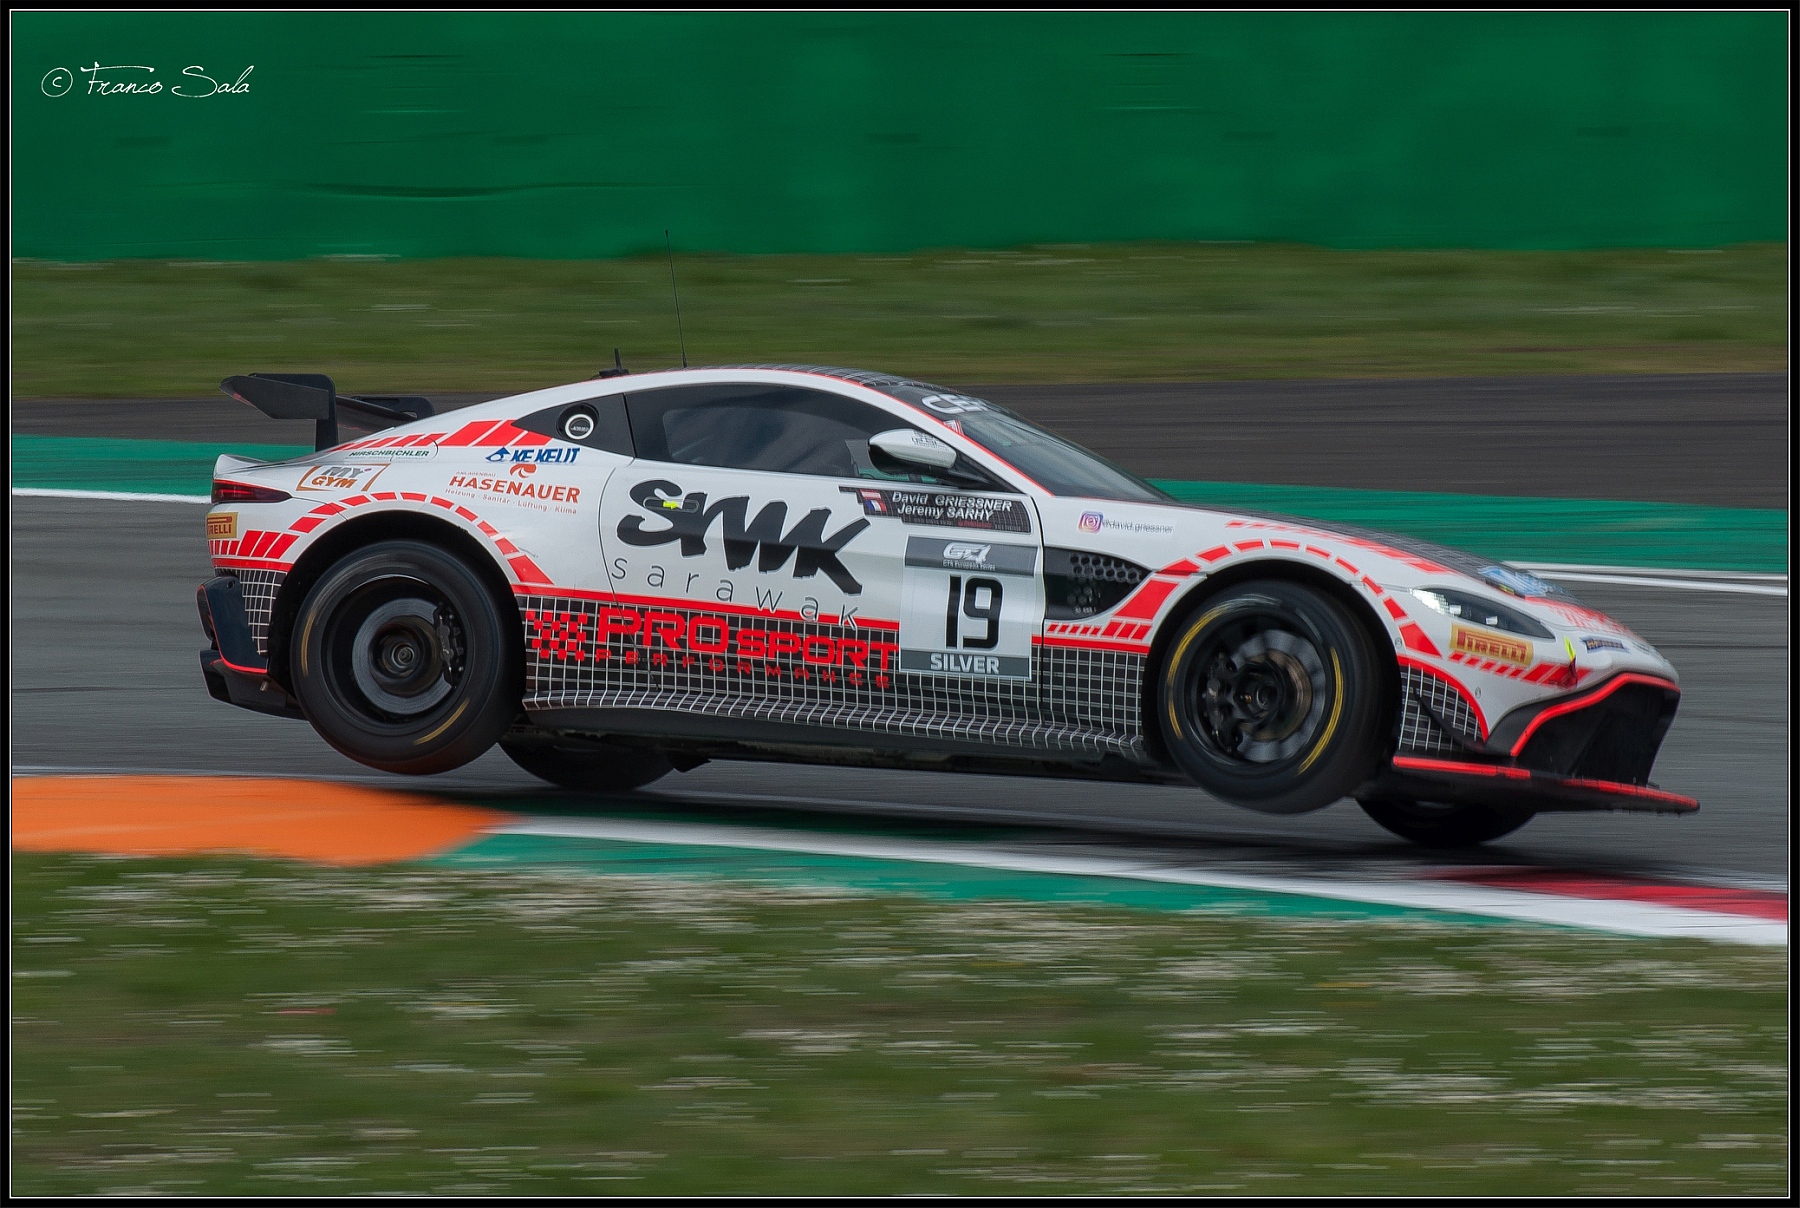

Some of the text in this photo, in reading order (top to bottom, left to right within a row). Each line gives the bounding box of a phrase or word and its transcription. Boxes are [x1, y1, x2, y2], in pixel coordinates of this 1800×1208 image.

[311, 475, 358, 489] GYM
[320, 466, 364, 479] MY
[445, 488, 476, 499] Heizung
[554, 506, 578, 515] Klima
[449, 475, 581, 504] HASENAUER
[892, 491, 1013, 512] David GRIESSNER
[897, 503, 994, 522] Jeremy SARHY
[611, 556, 859, 630] sarawak
[946, 574, 1003, 650] 19
[597, 607, 899, 671] PRO SPORT
[1456, 629, 1527, 663] PIRELLI
[595, 648, 890, 690] PERFORMANCE
[930, 653, 1000, 674] SILVER
